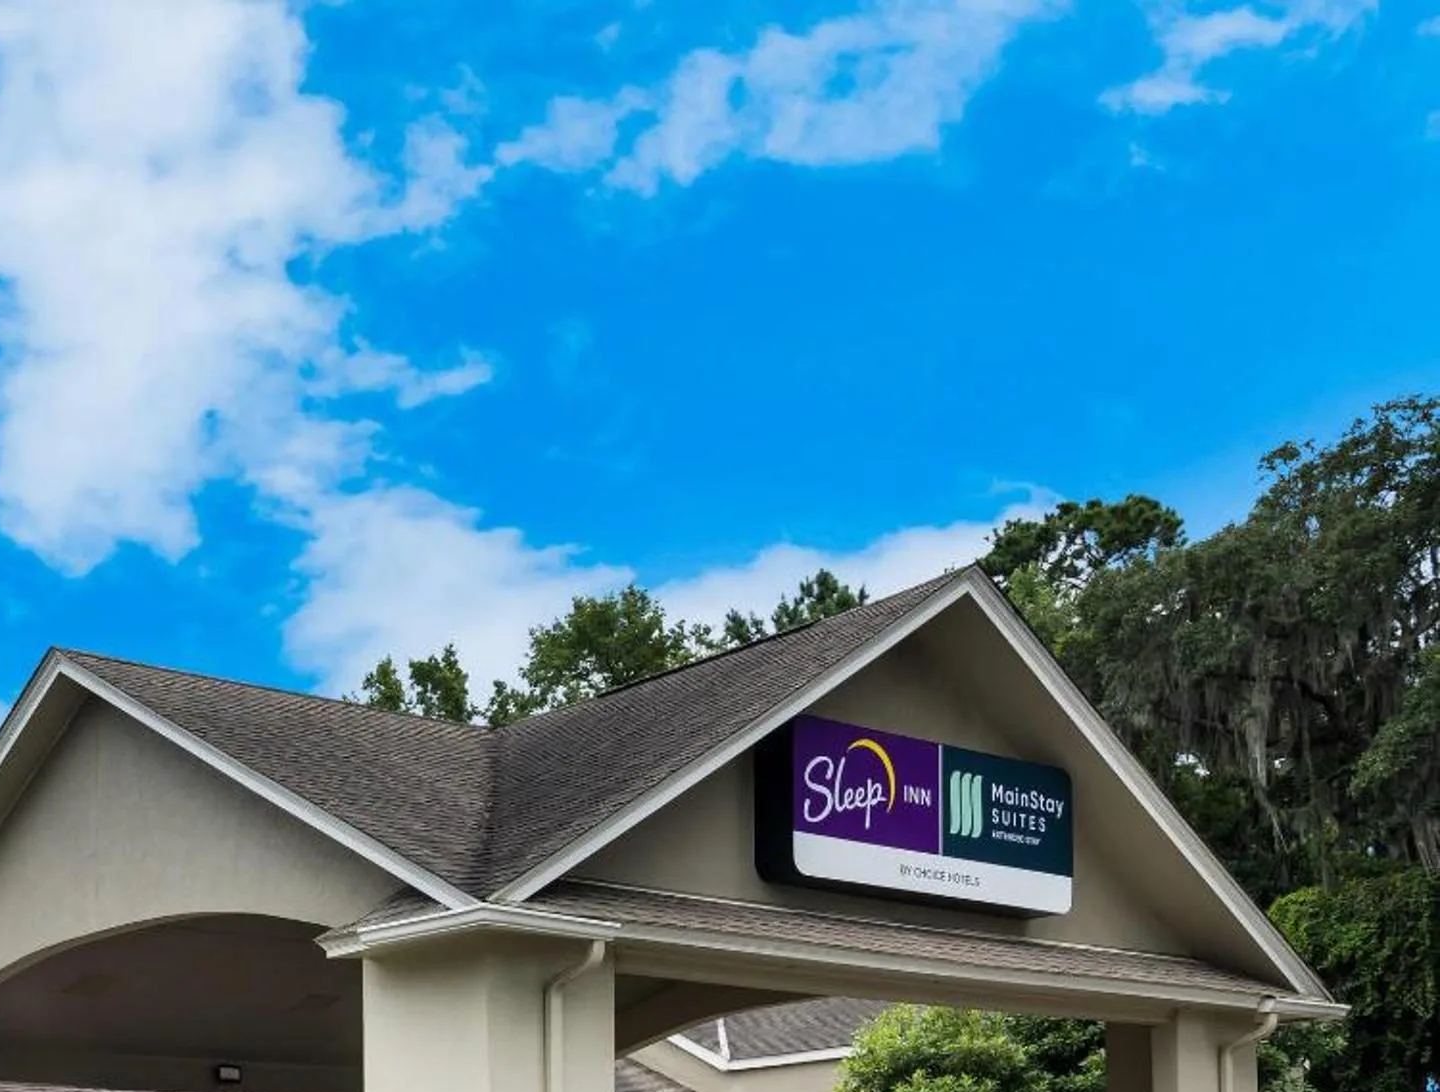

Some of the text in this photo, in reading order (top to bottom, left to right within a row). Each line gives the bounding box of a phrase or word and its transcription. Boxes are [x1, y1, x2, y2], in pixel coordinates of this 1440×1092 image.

[803, 755, 931, 830] Sleep INN
[992, 782, 1064, 819] MainStay
[992, 808, 1046, 832] SUITES
